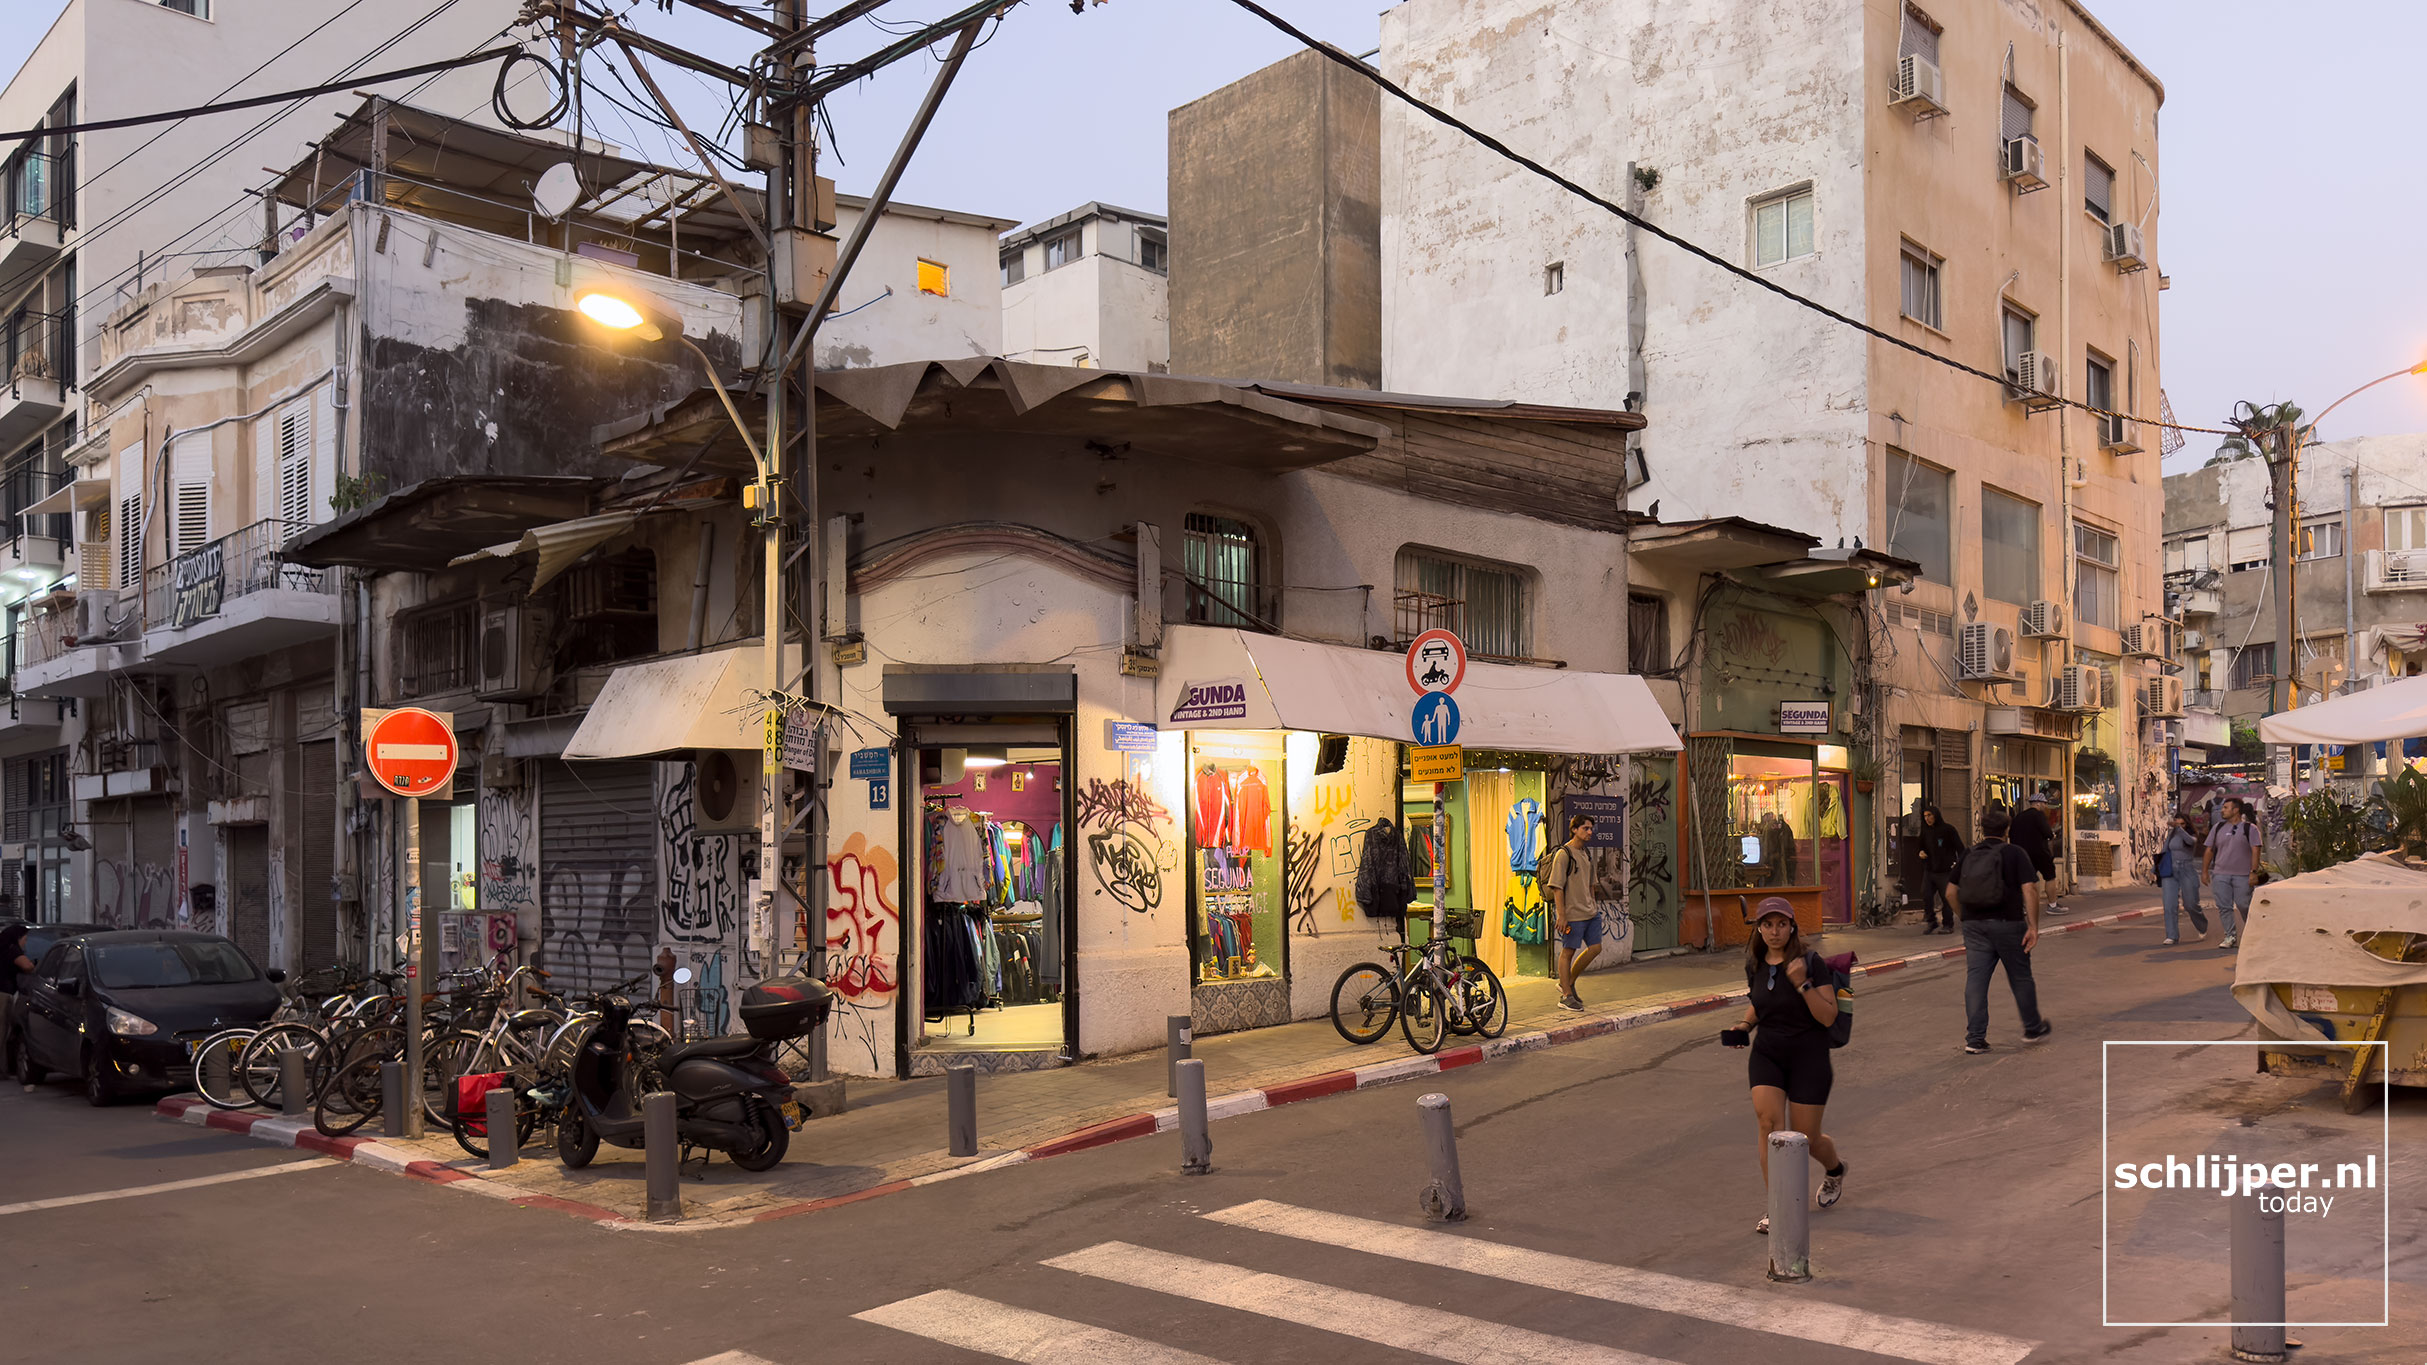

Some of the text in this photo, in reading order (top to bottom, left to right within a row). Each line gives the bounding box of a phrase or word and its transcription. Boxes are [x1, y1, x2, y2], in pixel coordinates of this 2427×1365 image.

[1188, 683, 1246, 706] GUNDA
[1174, 706, 1244, 720] VINTAGE & 2ND HAND
[1782, 710, 1827, 719] SEGUNDA
[784, 744, 802, 756] Danger
[854, 751, 879, 759] המשביר
[1414, 751, 1459, 762] למעט אופניים
[1418, 765, 1456, 775] לא ממונעים
[872, 785, 887, 802] 13
[1599, 815, 1616, 824] חדרים
[1616, 815, 1621, 824] 3
[1204, 866, 1255, 890] SEGUNDA
